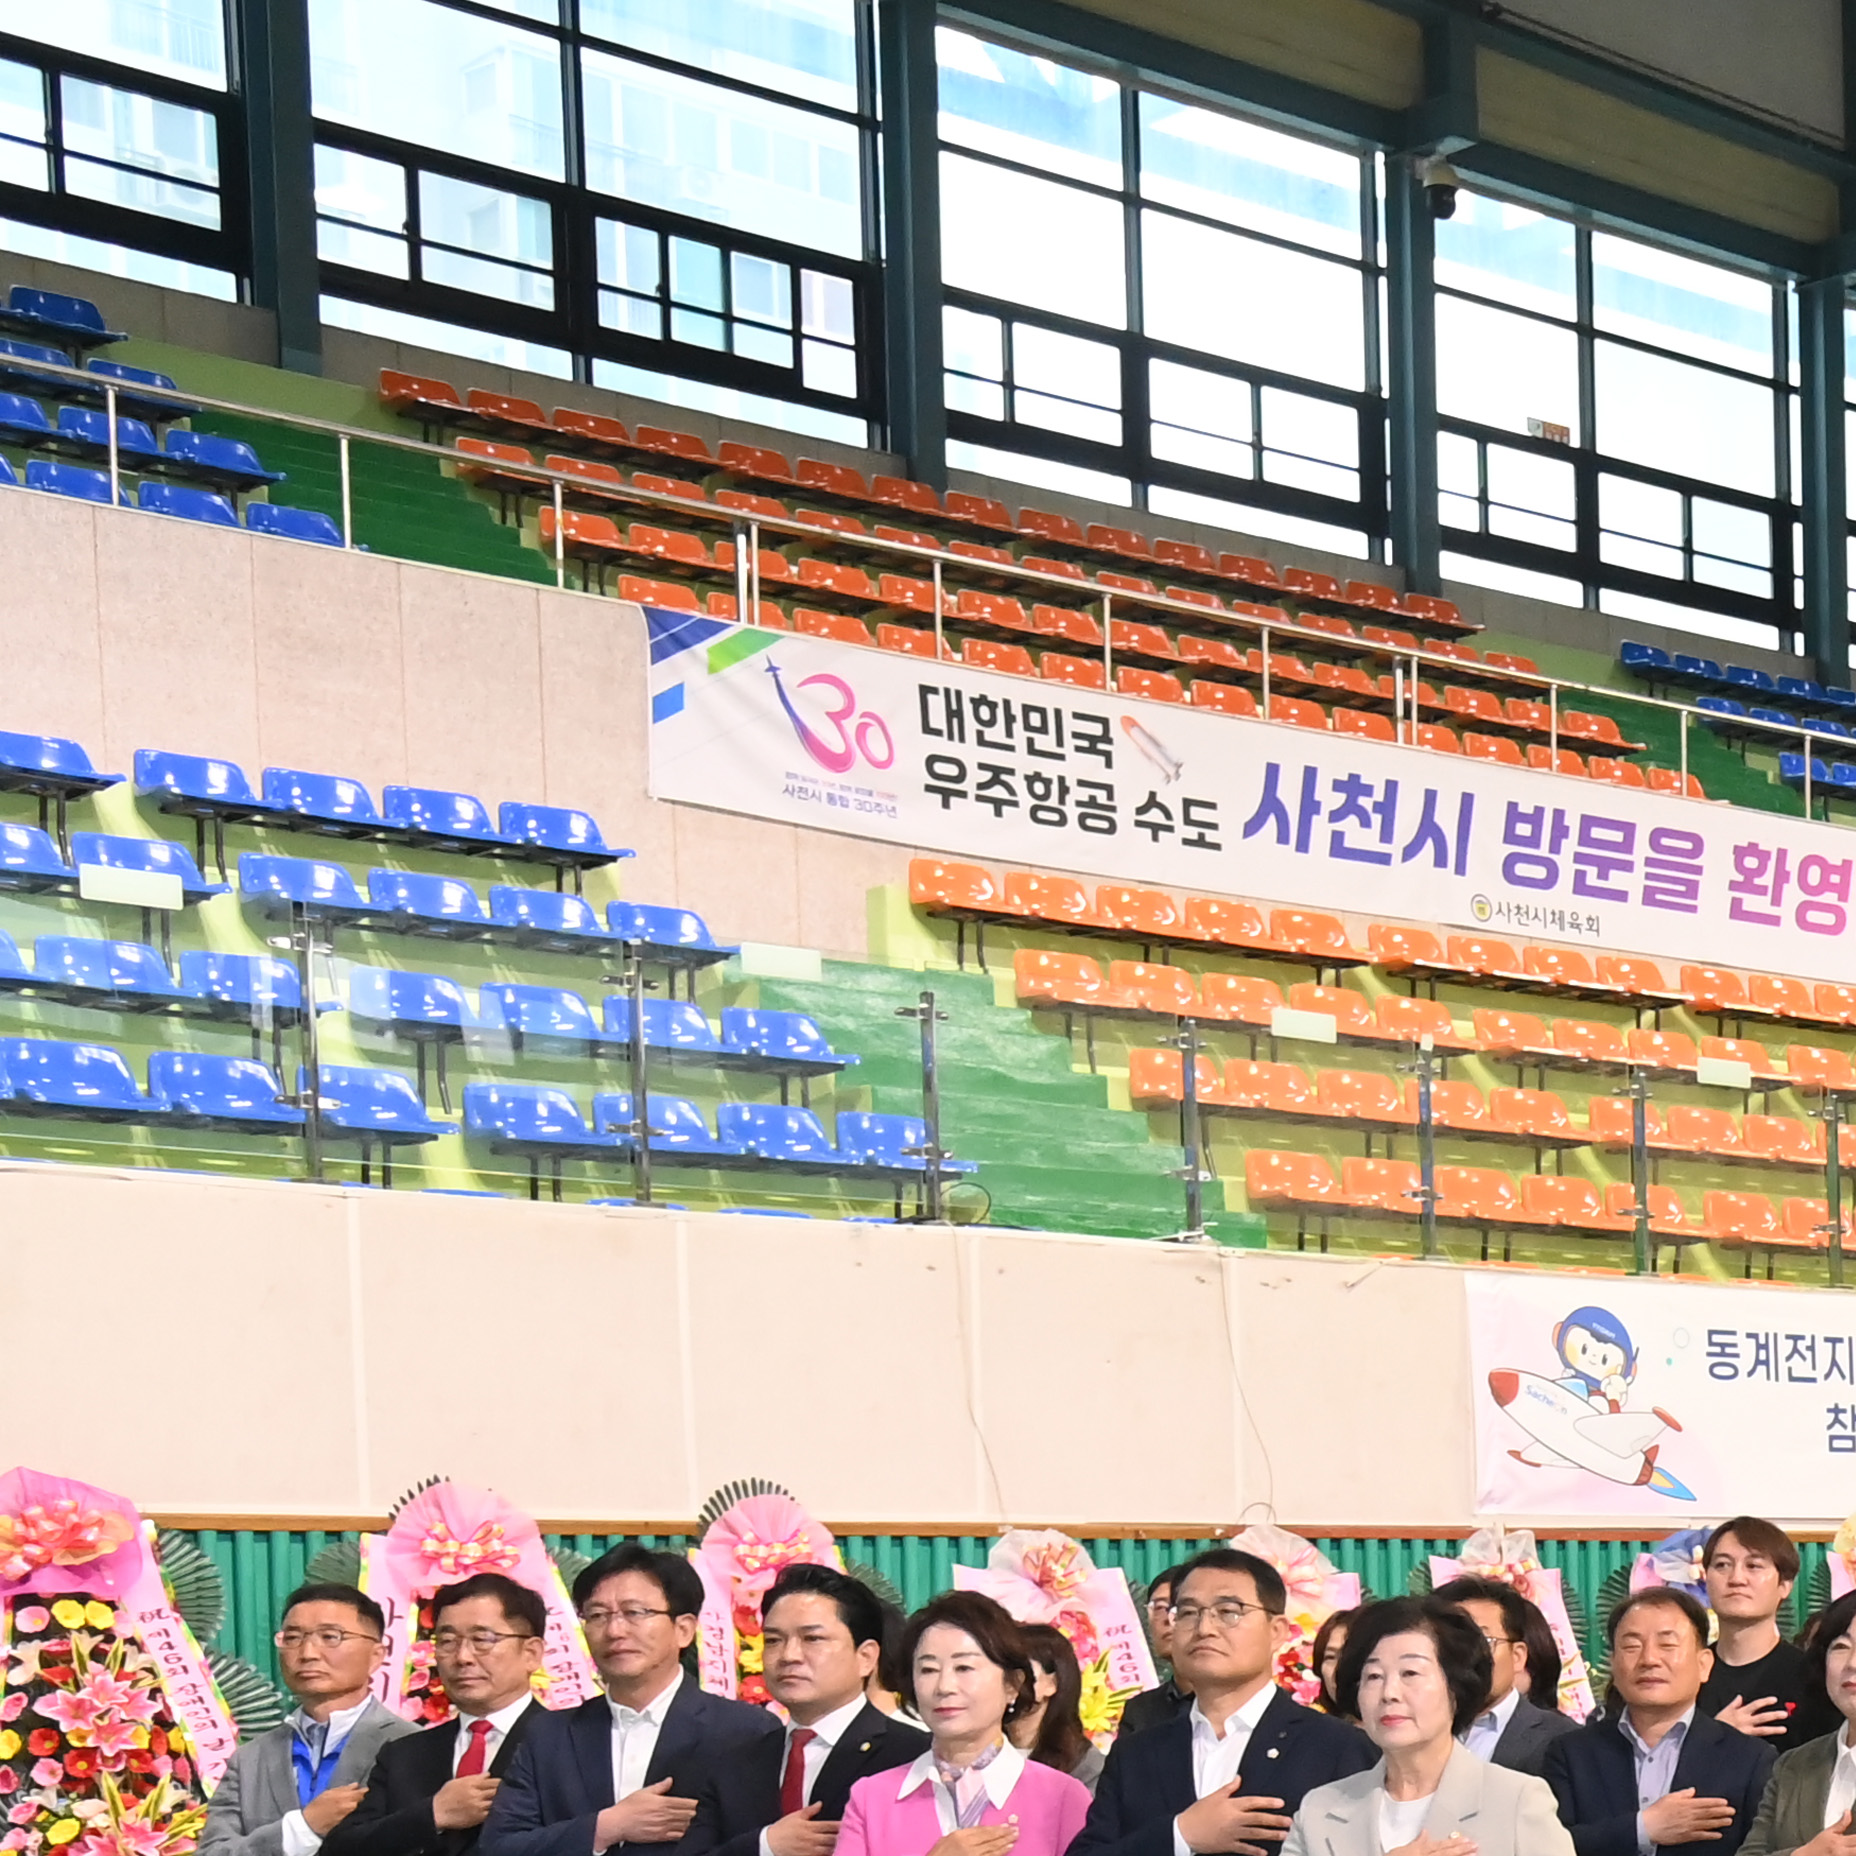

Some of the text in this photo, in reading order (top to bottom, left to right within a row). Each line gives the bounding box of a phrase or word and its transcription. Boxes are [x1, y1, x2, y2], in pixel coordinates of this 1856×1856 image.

[919, 683, 1114, 770] 대한민국
[924, 750, 1223, 851] 우주항공 수도
[1242, 761, 1476, 876] 사천시
[1500, 799, 1705, 915] 방문을
[1494, 897, 1601, 935] 사천시체육회
